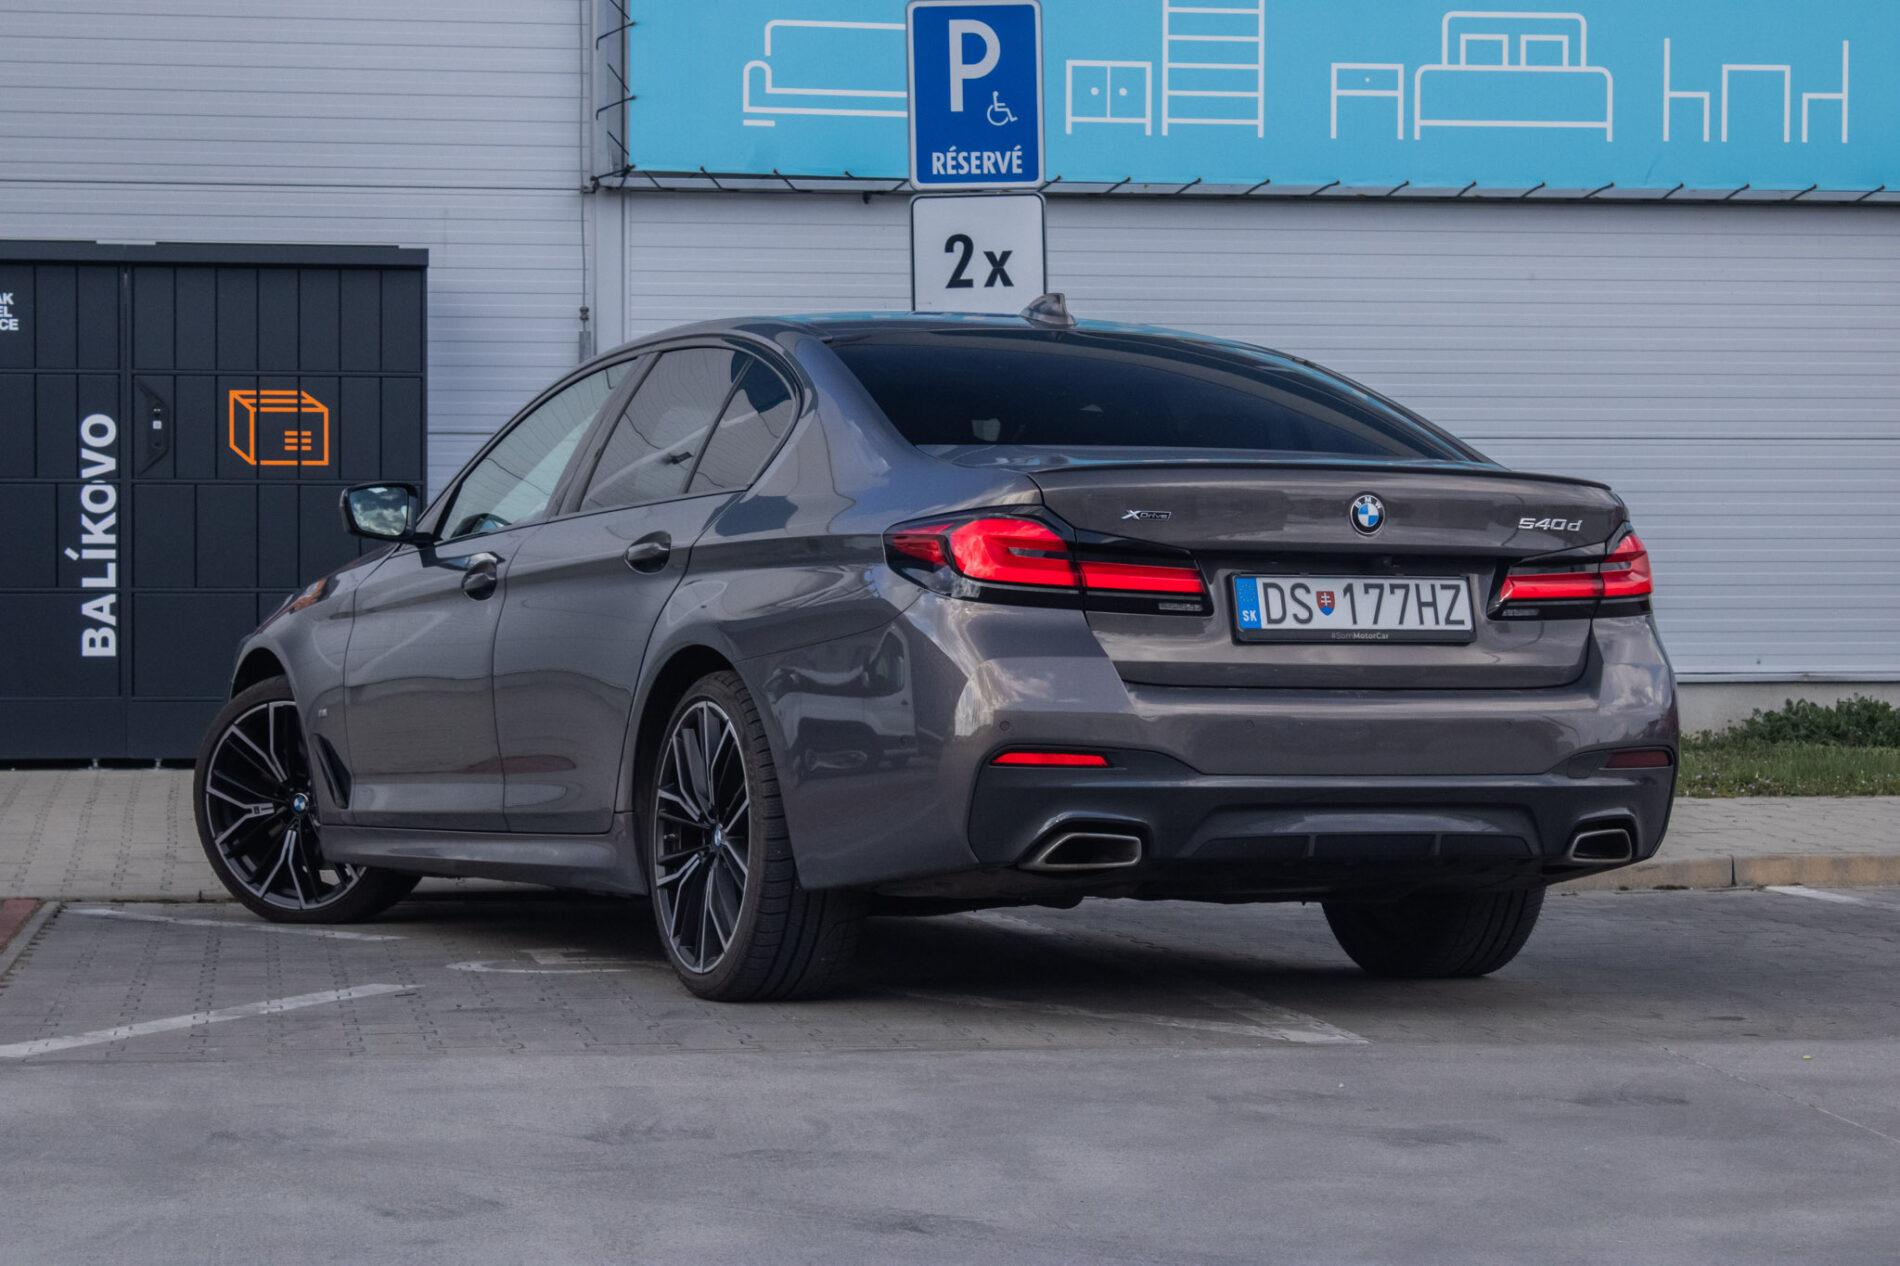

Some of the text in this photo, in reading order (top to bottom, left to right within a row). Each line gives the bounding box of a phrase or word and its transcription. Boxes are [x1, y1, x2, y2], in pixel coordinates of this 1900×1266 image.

[949, 19, 1001, 112] P
[932, 145, 1023, 175] RÉSERVÉ
[65, 413, 117, 658] BALÍKOVO
[1518, 517, 1583, 532] 540d
[1243, 609, 1257, 622] SK
[1262, 582, 1466, 626] DS 177HZ
